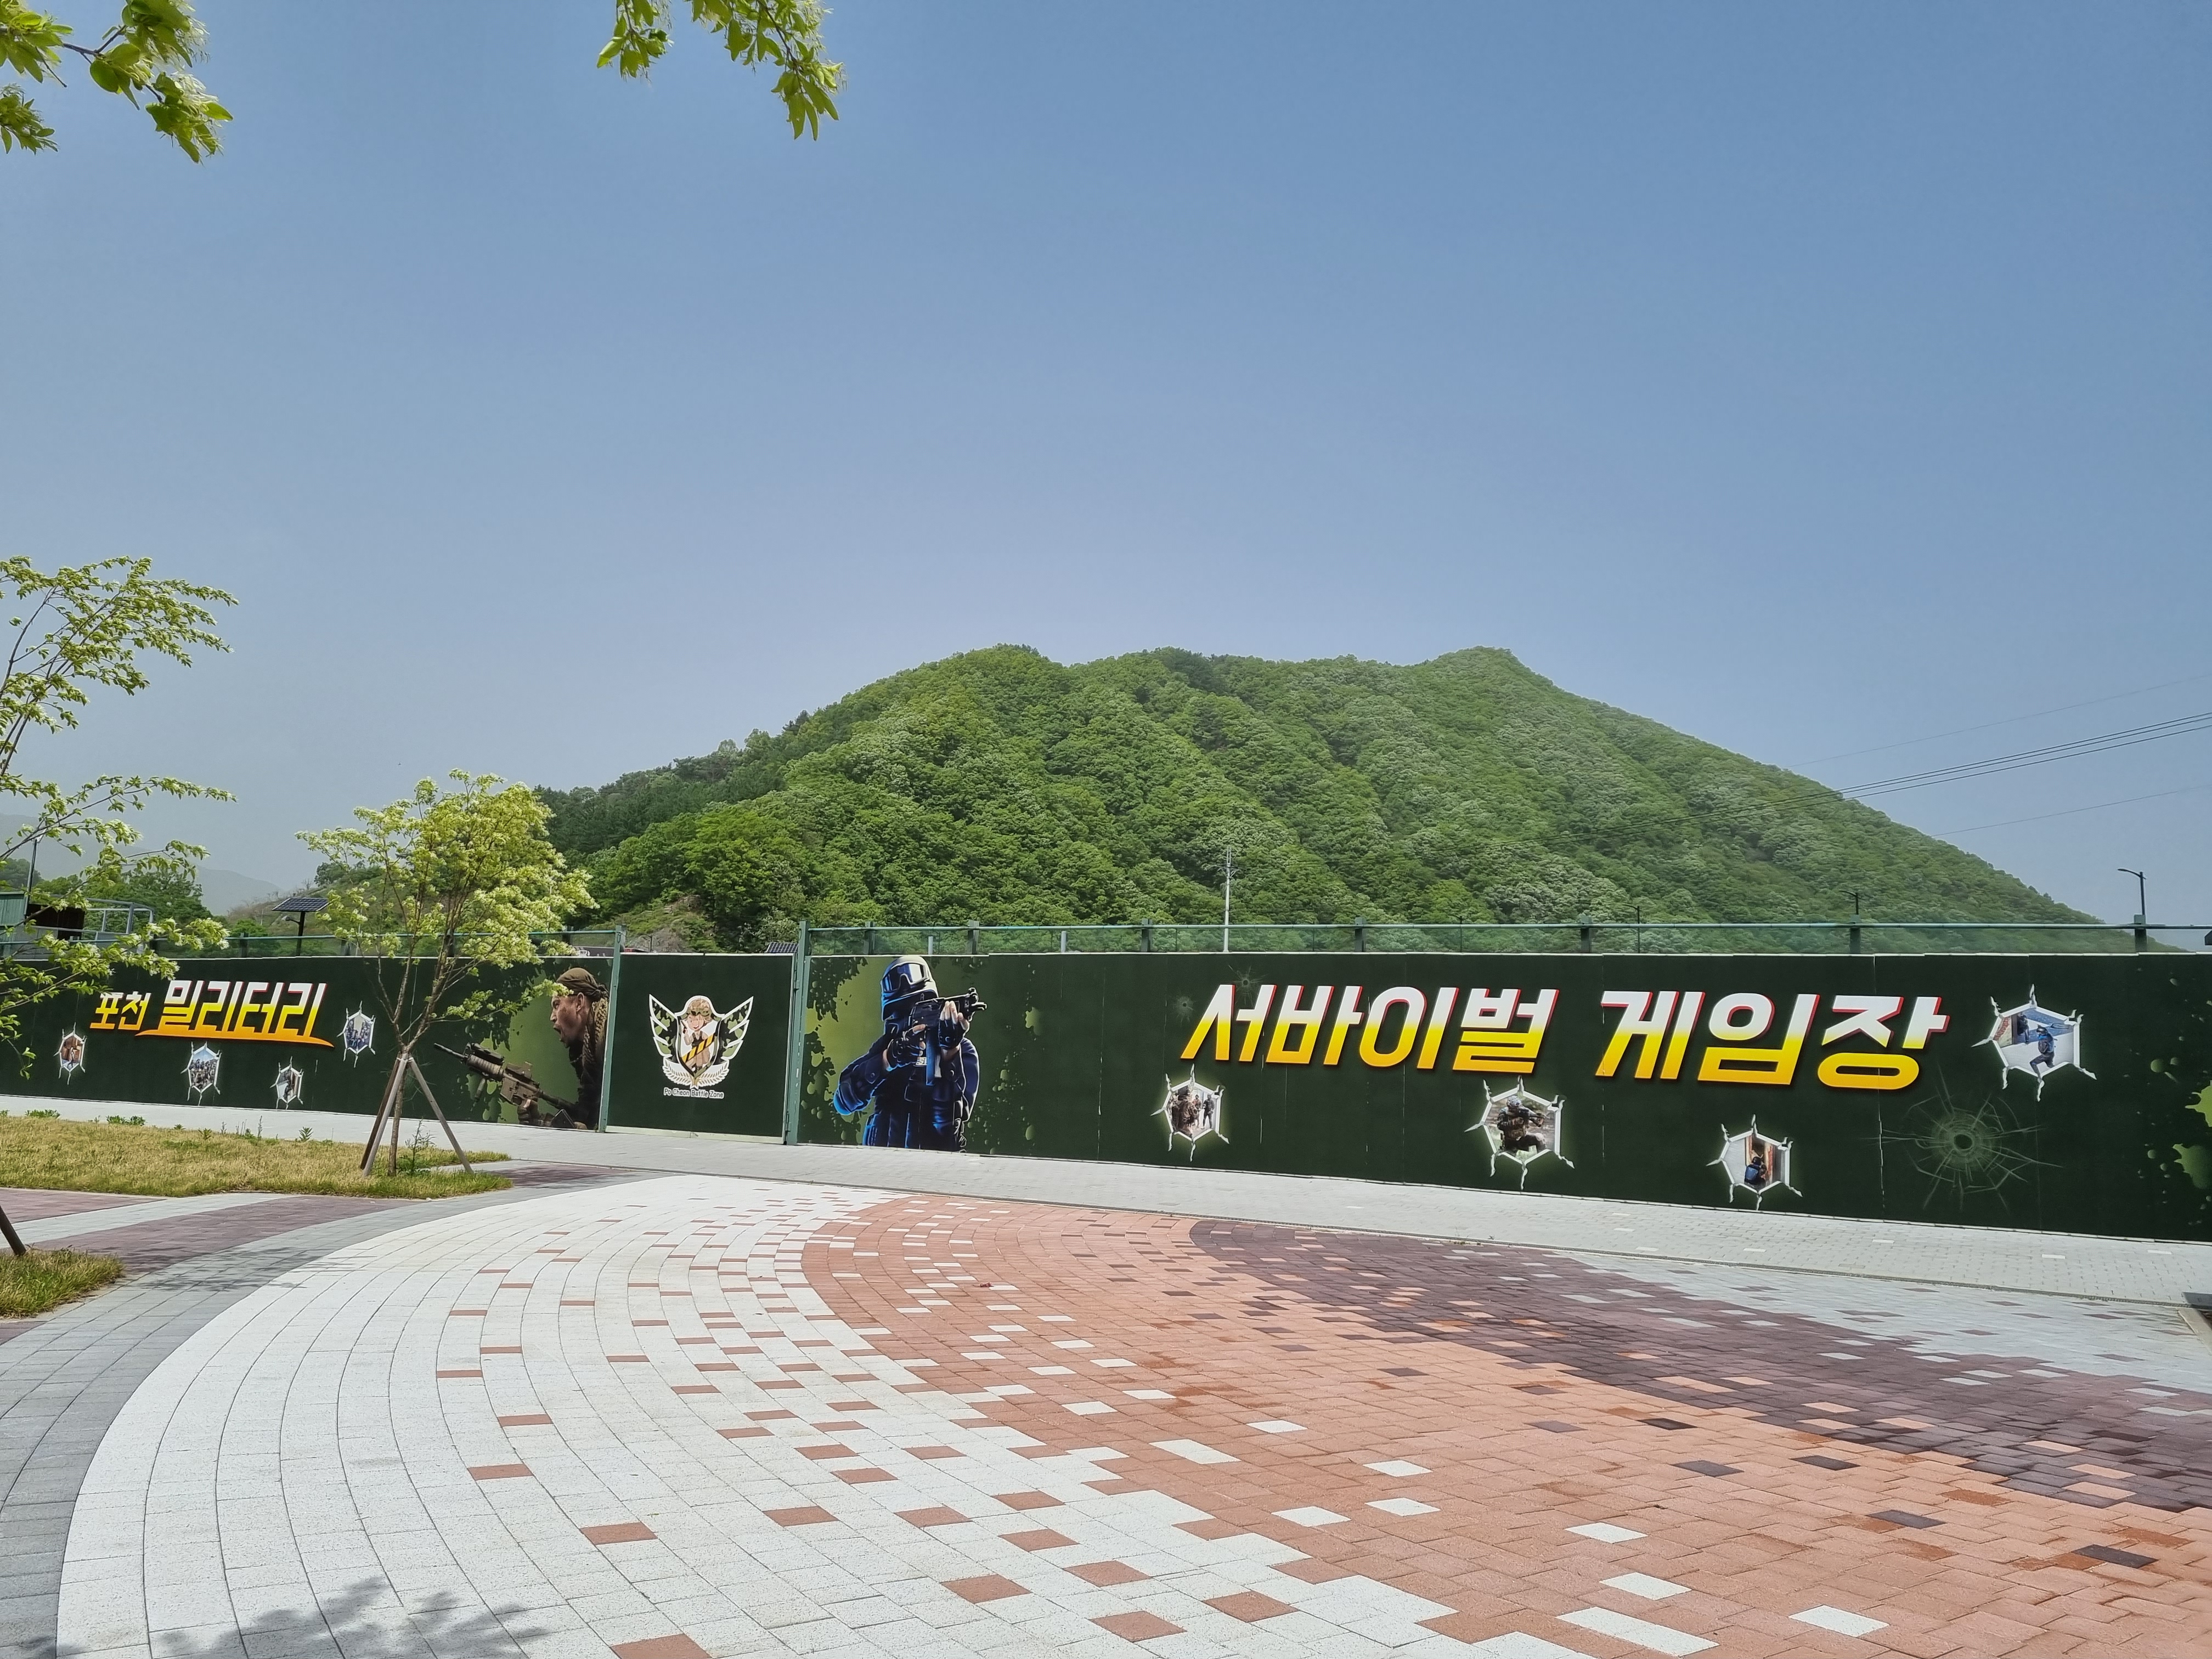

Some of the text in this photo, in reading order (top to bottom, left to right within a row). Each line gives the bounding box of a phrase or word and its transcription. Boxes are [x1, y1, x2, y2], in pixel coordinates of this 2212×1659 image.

[89, 979, 328, 1039] 포천 밀리터리
[1180, 984, 1950, 1090] 서바이벌 게임장
